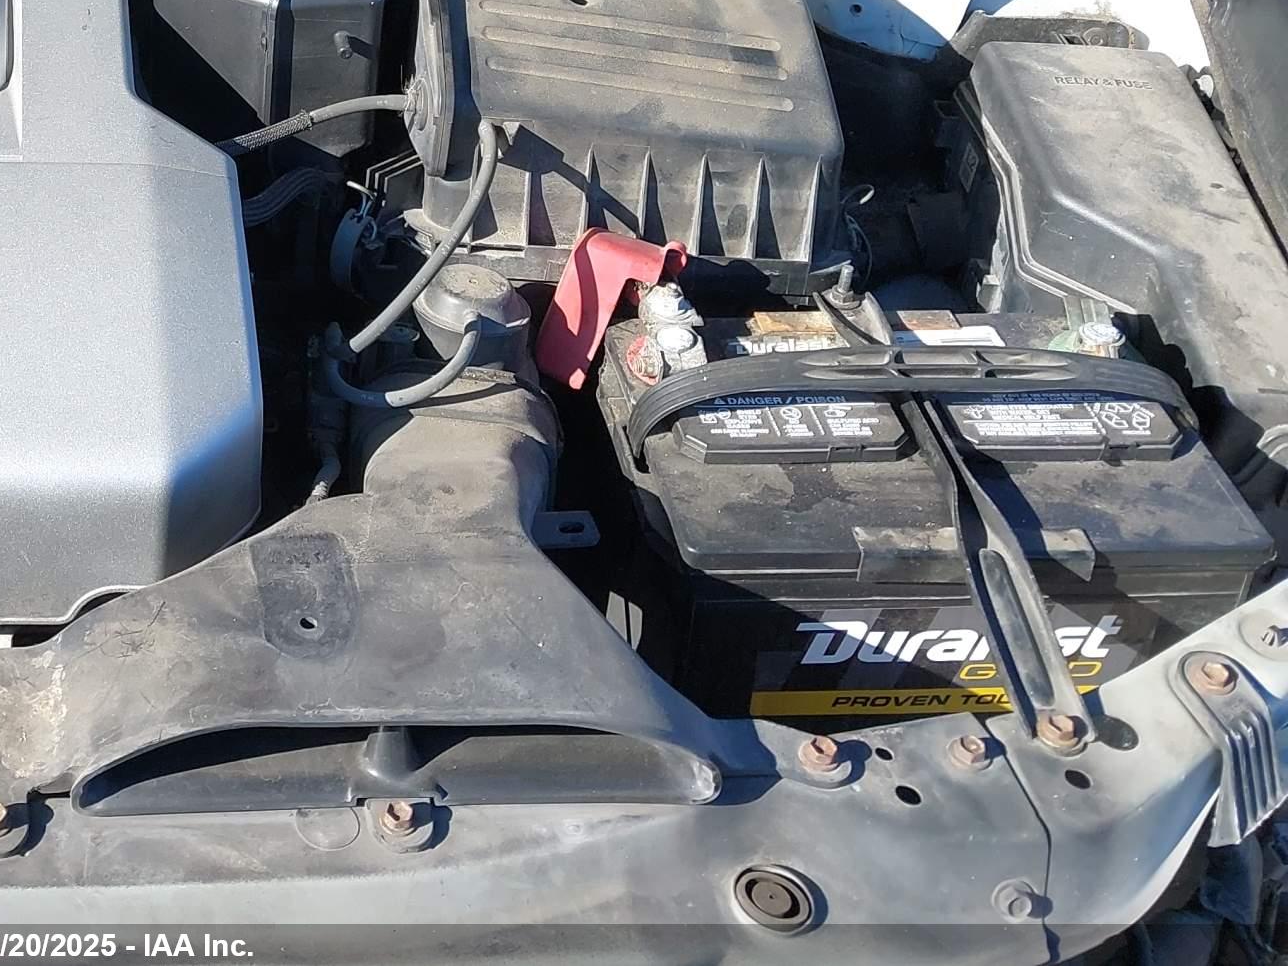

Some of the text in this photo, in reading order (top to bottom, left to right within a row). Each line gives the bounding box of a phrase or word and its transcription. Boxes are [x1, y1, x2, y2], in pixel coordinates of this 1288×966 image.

[1054, 75, 1099, 86] RELAY
[1114, 78, 1153, 90] FUSE
[727, 396, 783, 405] DANGER
[797, 395, 847, 404] POISON
[796, 615, 1123, 666] Duralst
[959, 661, 1103, 680] GD
[831, 693, 1012, 708] PROVEN TOU
